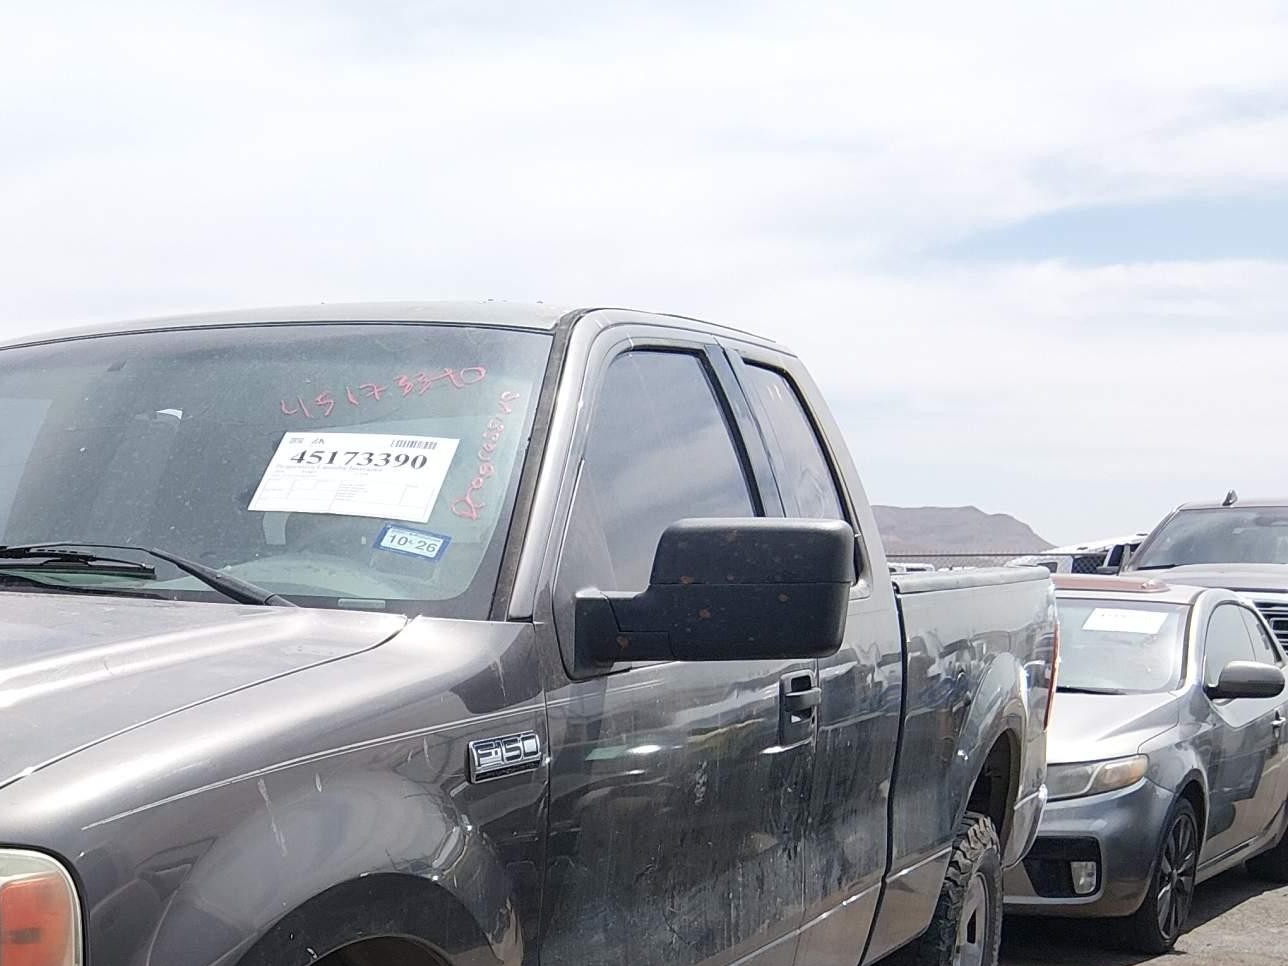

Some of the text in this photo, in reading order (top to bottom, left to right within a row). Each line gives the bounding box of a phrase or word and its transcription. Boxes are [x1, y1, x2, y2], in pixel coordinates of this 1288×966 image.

[289, 449, 429, 470] 45173390
[389, 533, 410, 547] 10
[415, 539, 439, 553] 26
